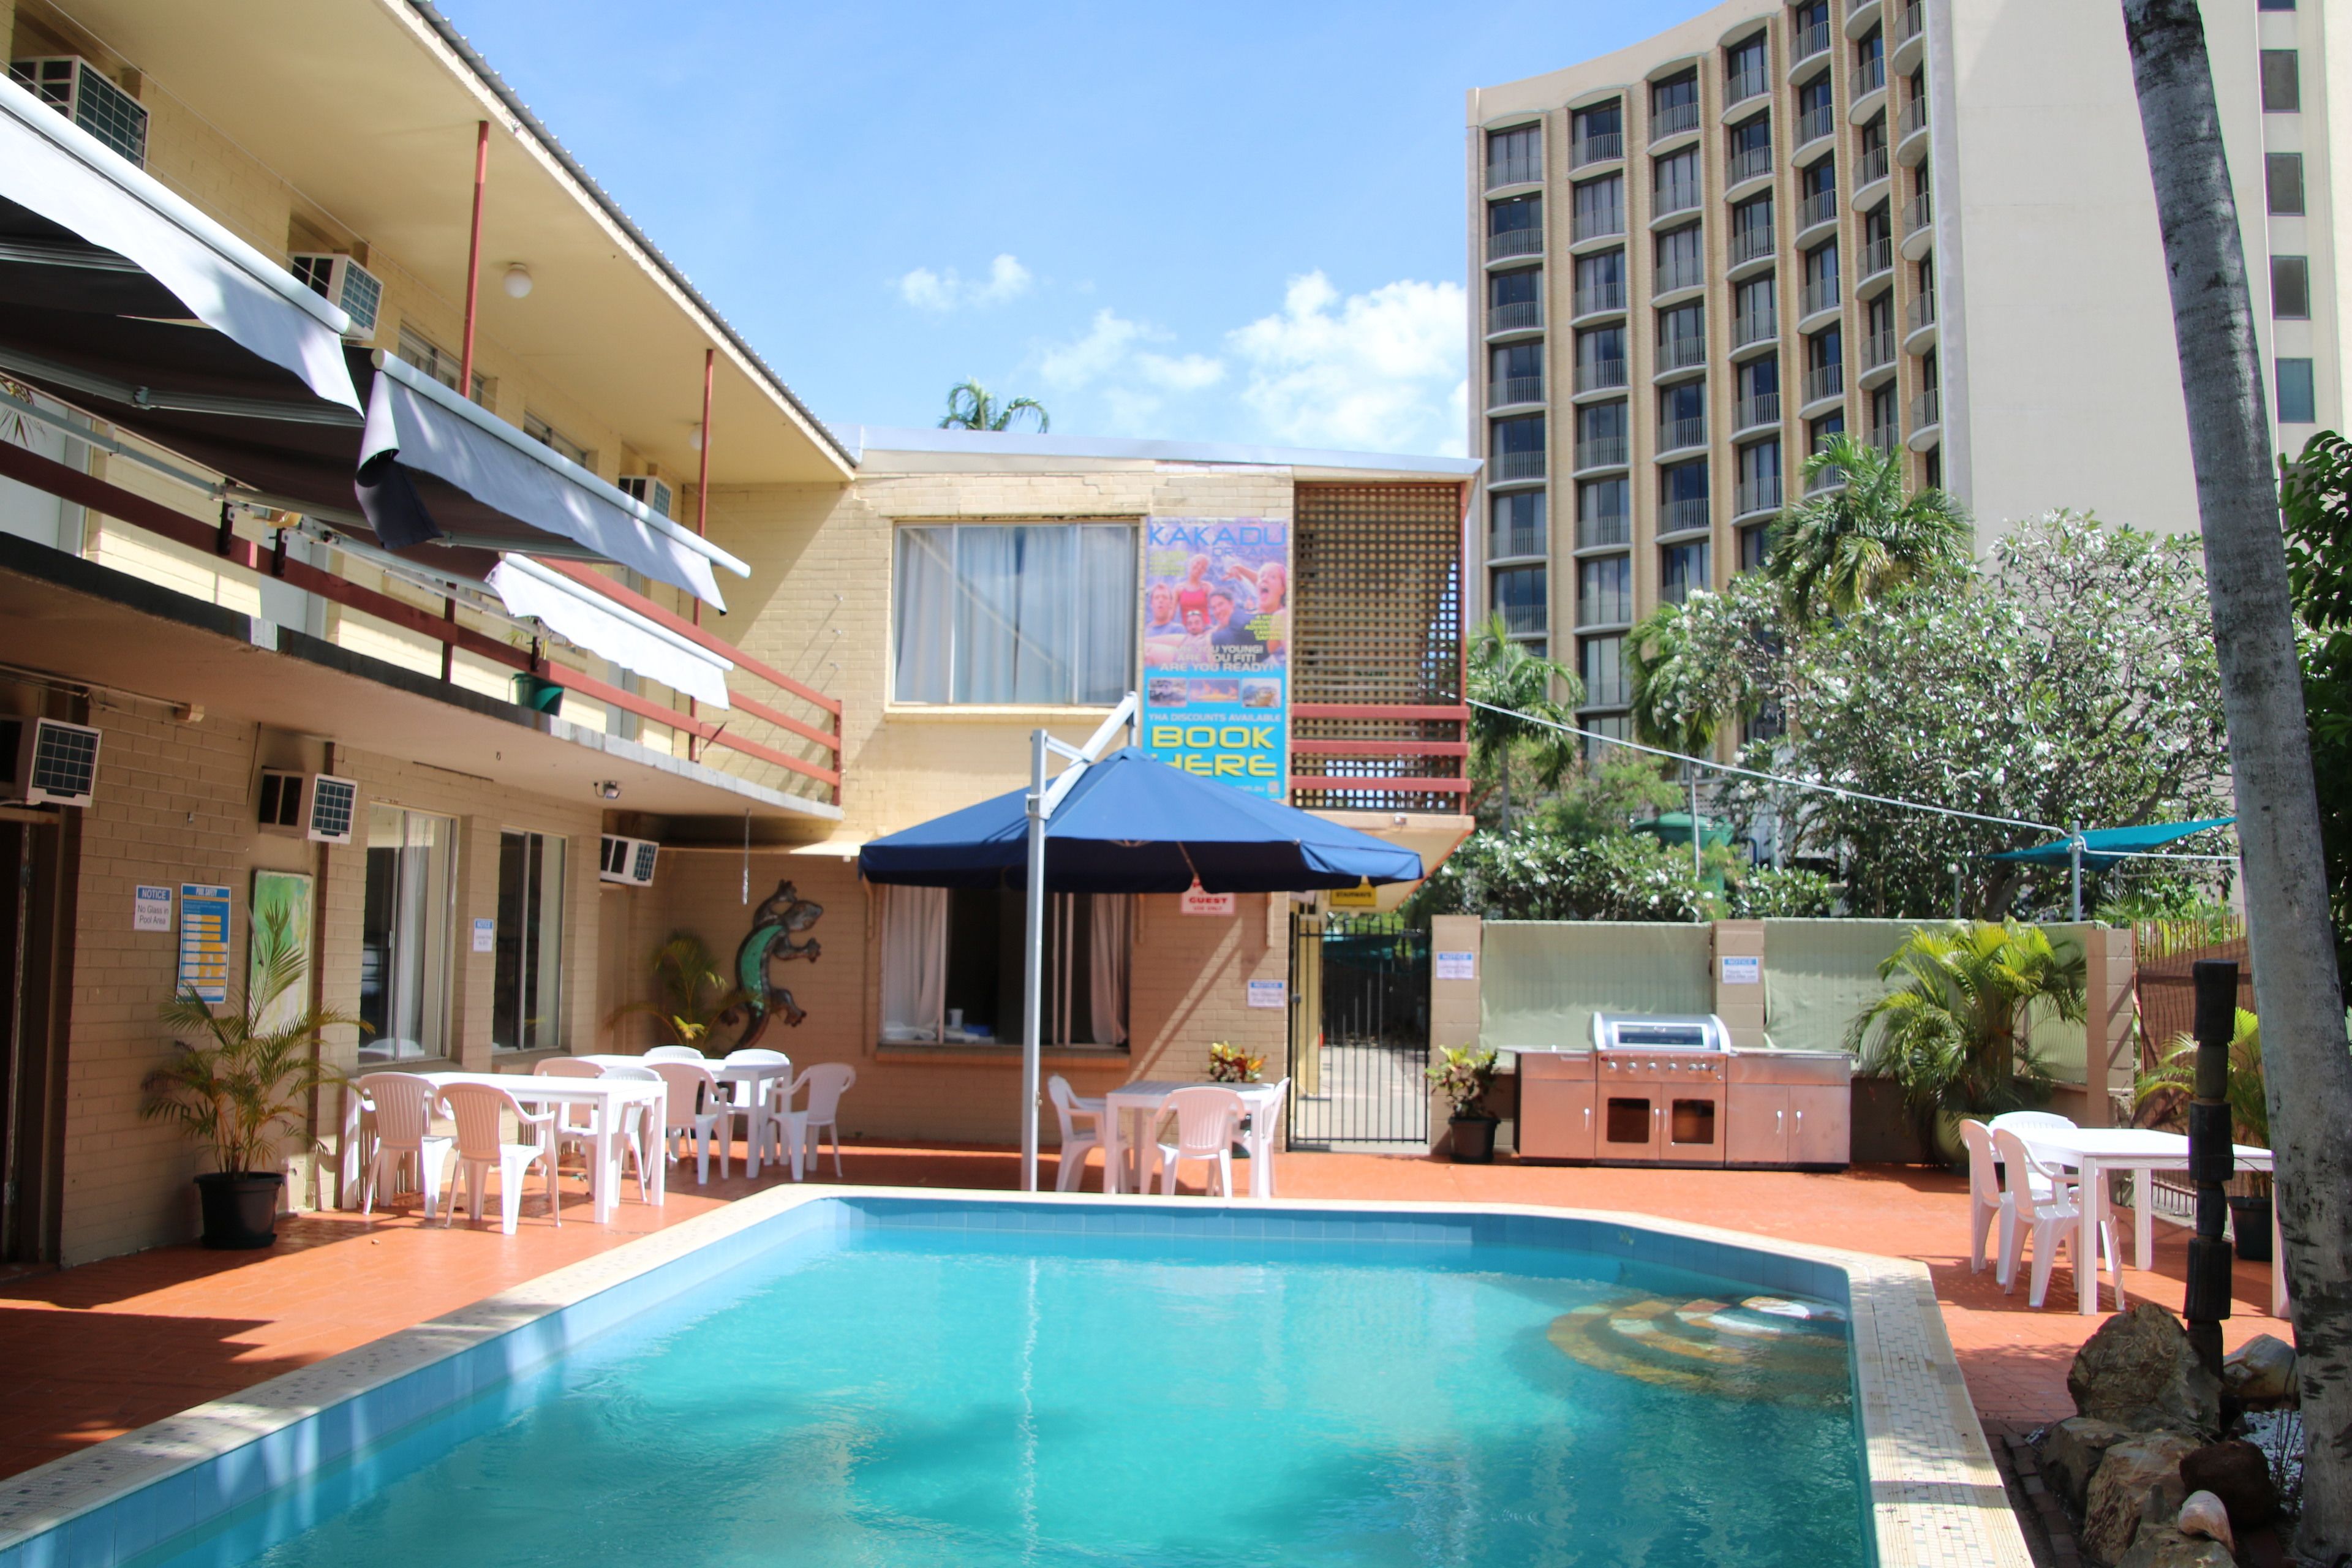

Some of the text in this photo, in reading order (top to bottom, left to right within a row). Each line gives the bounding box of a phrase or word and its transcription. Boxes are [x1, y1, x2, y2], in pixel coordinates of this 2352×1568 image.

[1148, 527, 1286, 546] KAKADU
[1207, 654, 1231, 662] YOU
[1159, 663, 1274, 672] ARE YOU READY!
[1229, 714, 1281, 722] AVAILABLE
[1152, 726, 1275, 748] BOOK
[141, 889, 166, 899] NOTICE
[196, 887, 218, 897] POOL SAFETY
[147, 905, 163, 914] Glass
[139, 915, 166, 925] Pool Area
